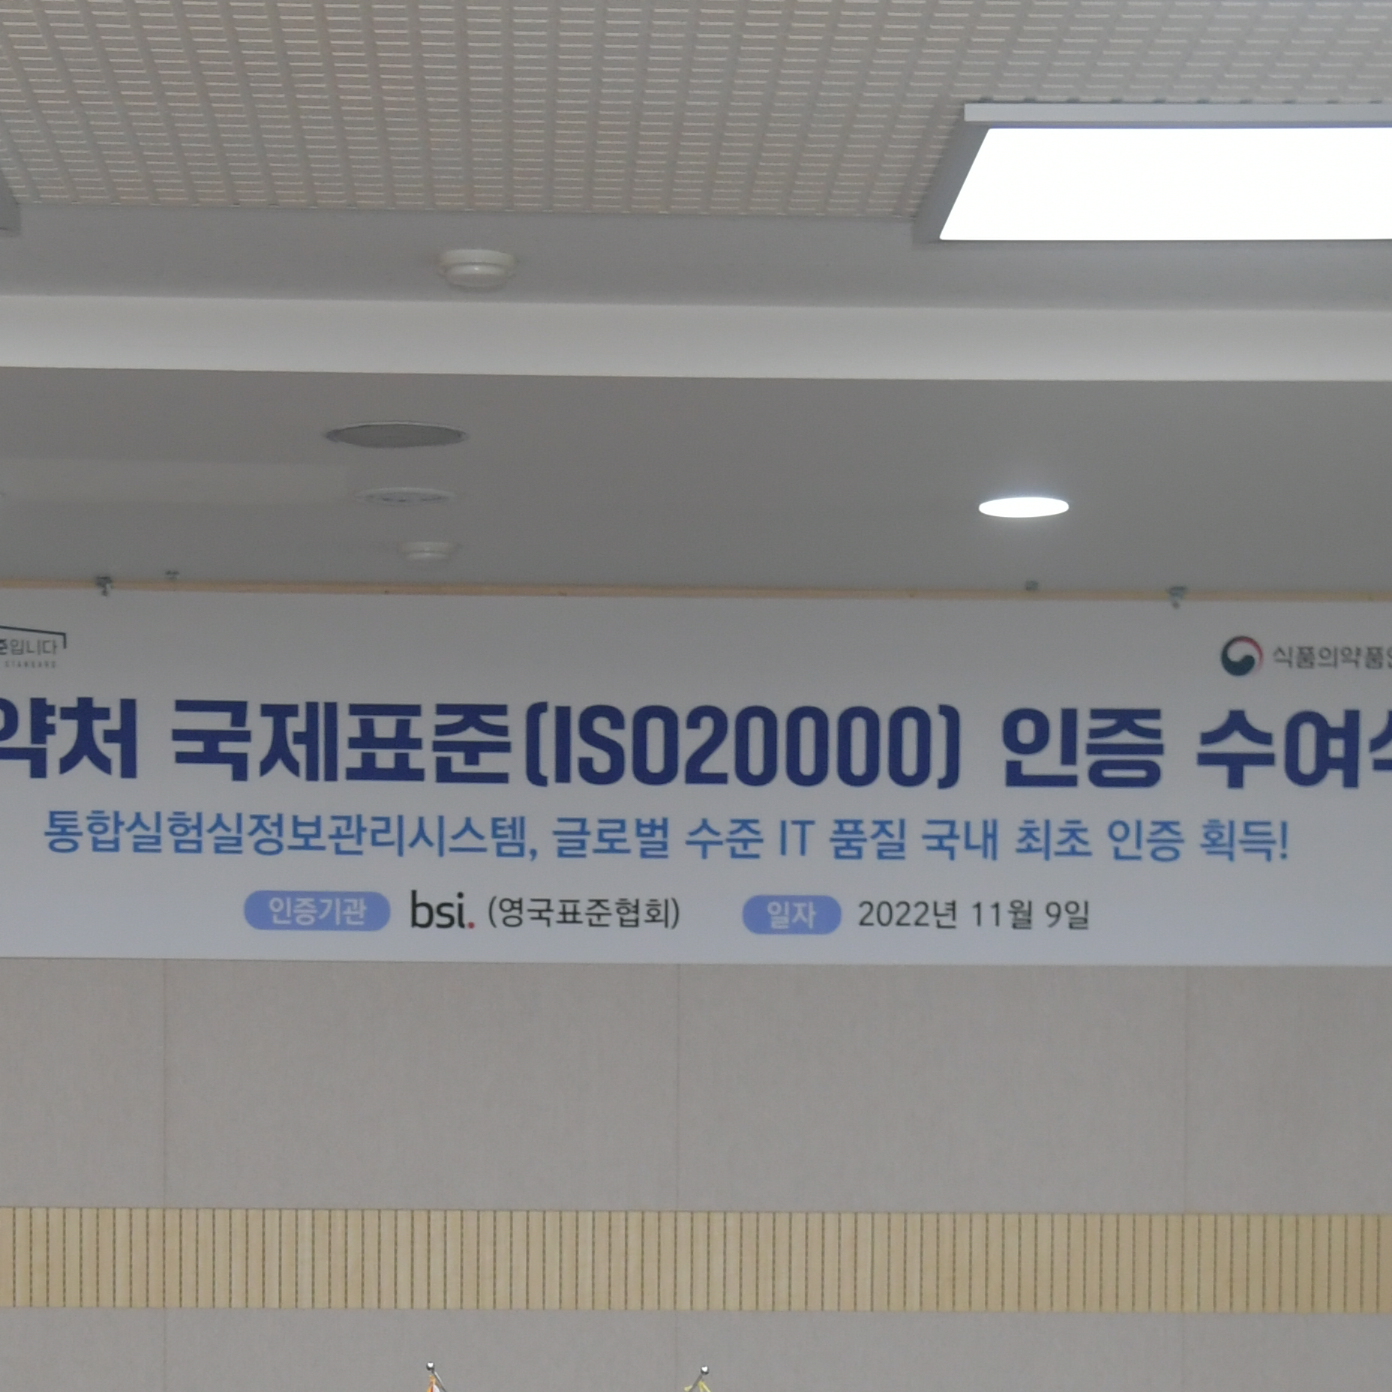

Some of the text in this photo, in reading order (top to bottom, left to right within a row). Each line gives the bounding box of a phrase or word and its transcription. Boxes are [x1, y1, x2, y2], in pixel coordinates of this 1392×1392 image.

[1002, 708, 1166, 790] 인증
[43, 810, 1289, 864] 통합실험실정보관리시스템, 글로벌 수준 IT 품질 국내 최초 인증 획득!
[267, 896, 369, 926] 인증기관
[489, 897, 681, 930] (영국표준협회)
[766, 900, 817, 930] 일자
[859, 900, 1090, 931] 2022년 11월 9일
